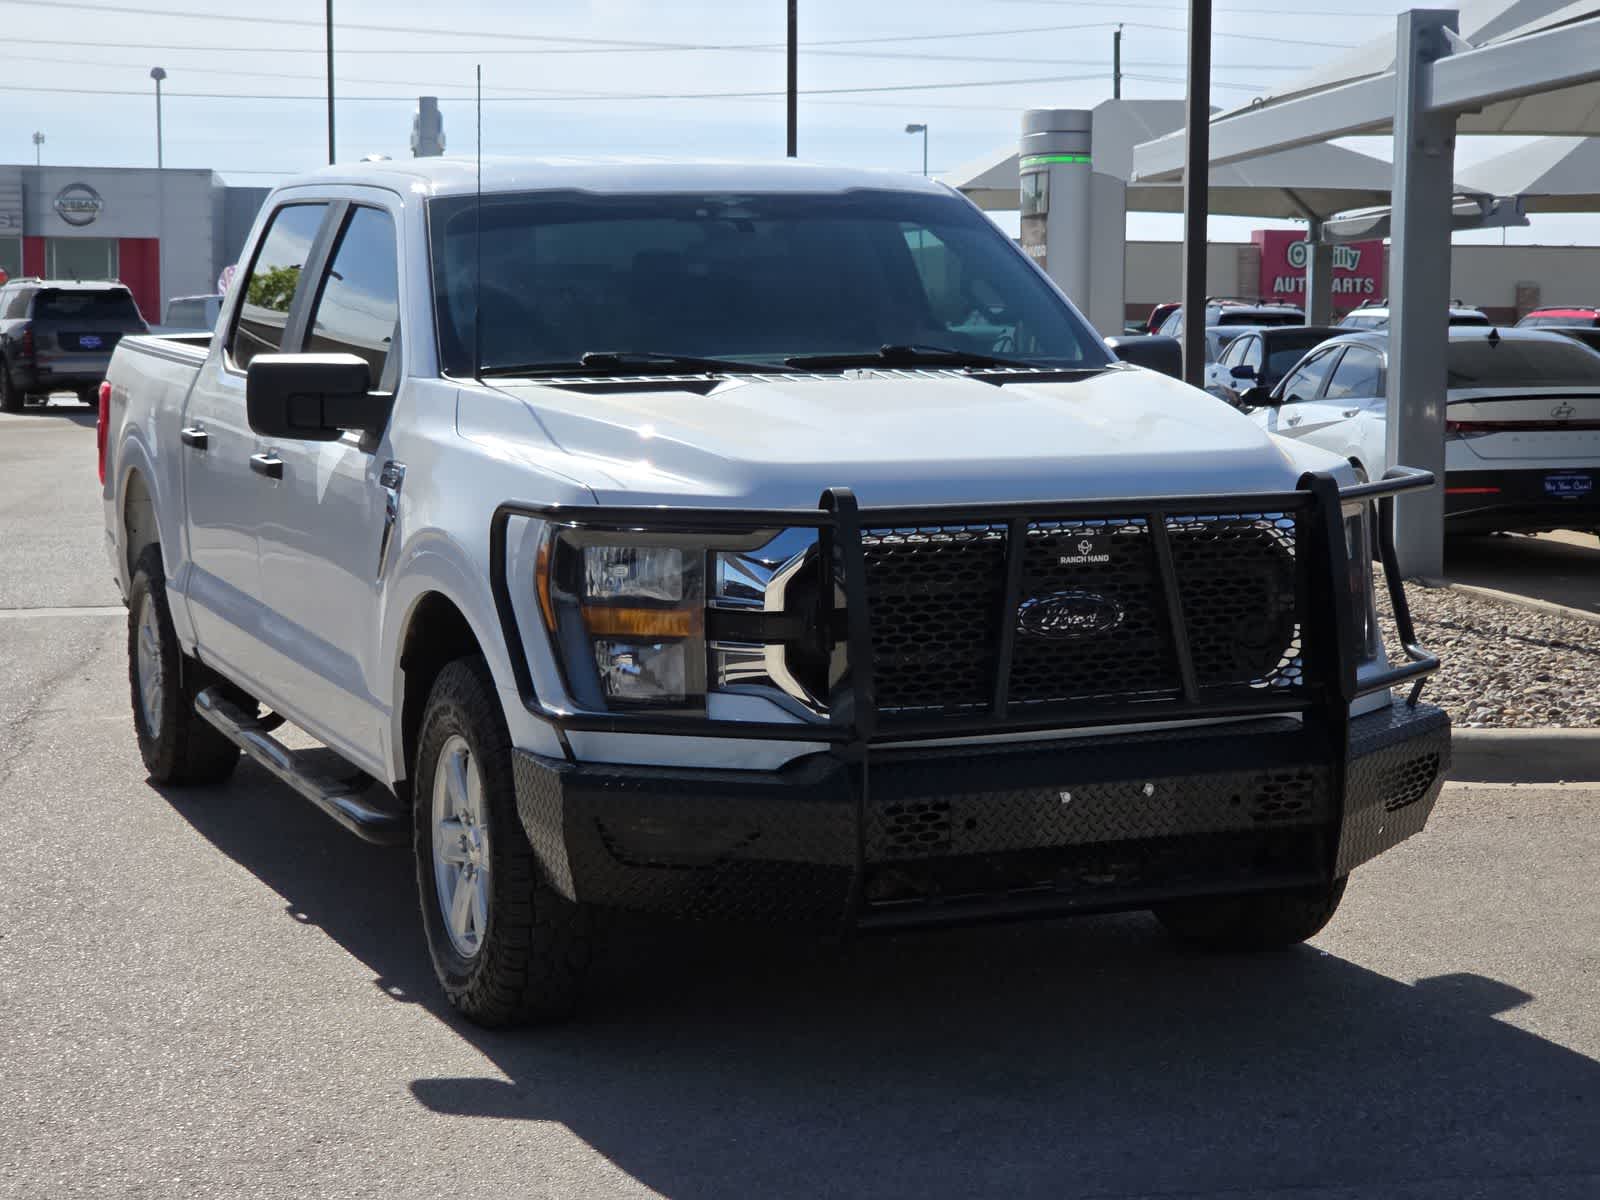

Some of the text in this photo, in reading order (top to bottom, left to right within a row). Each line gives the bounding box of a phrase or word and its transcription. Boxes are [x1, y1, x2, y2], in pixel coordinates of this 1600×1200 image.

[58, 199, 98, 209] NISSAN
[1273, 276, 1375, 294] AUT ARTS
[1060, 554, 1110, 564] RANCH HAND
[1039, 606, 1097, 630] Ford
